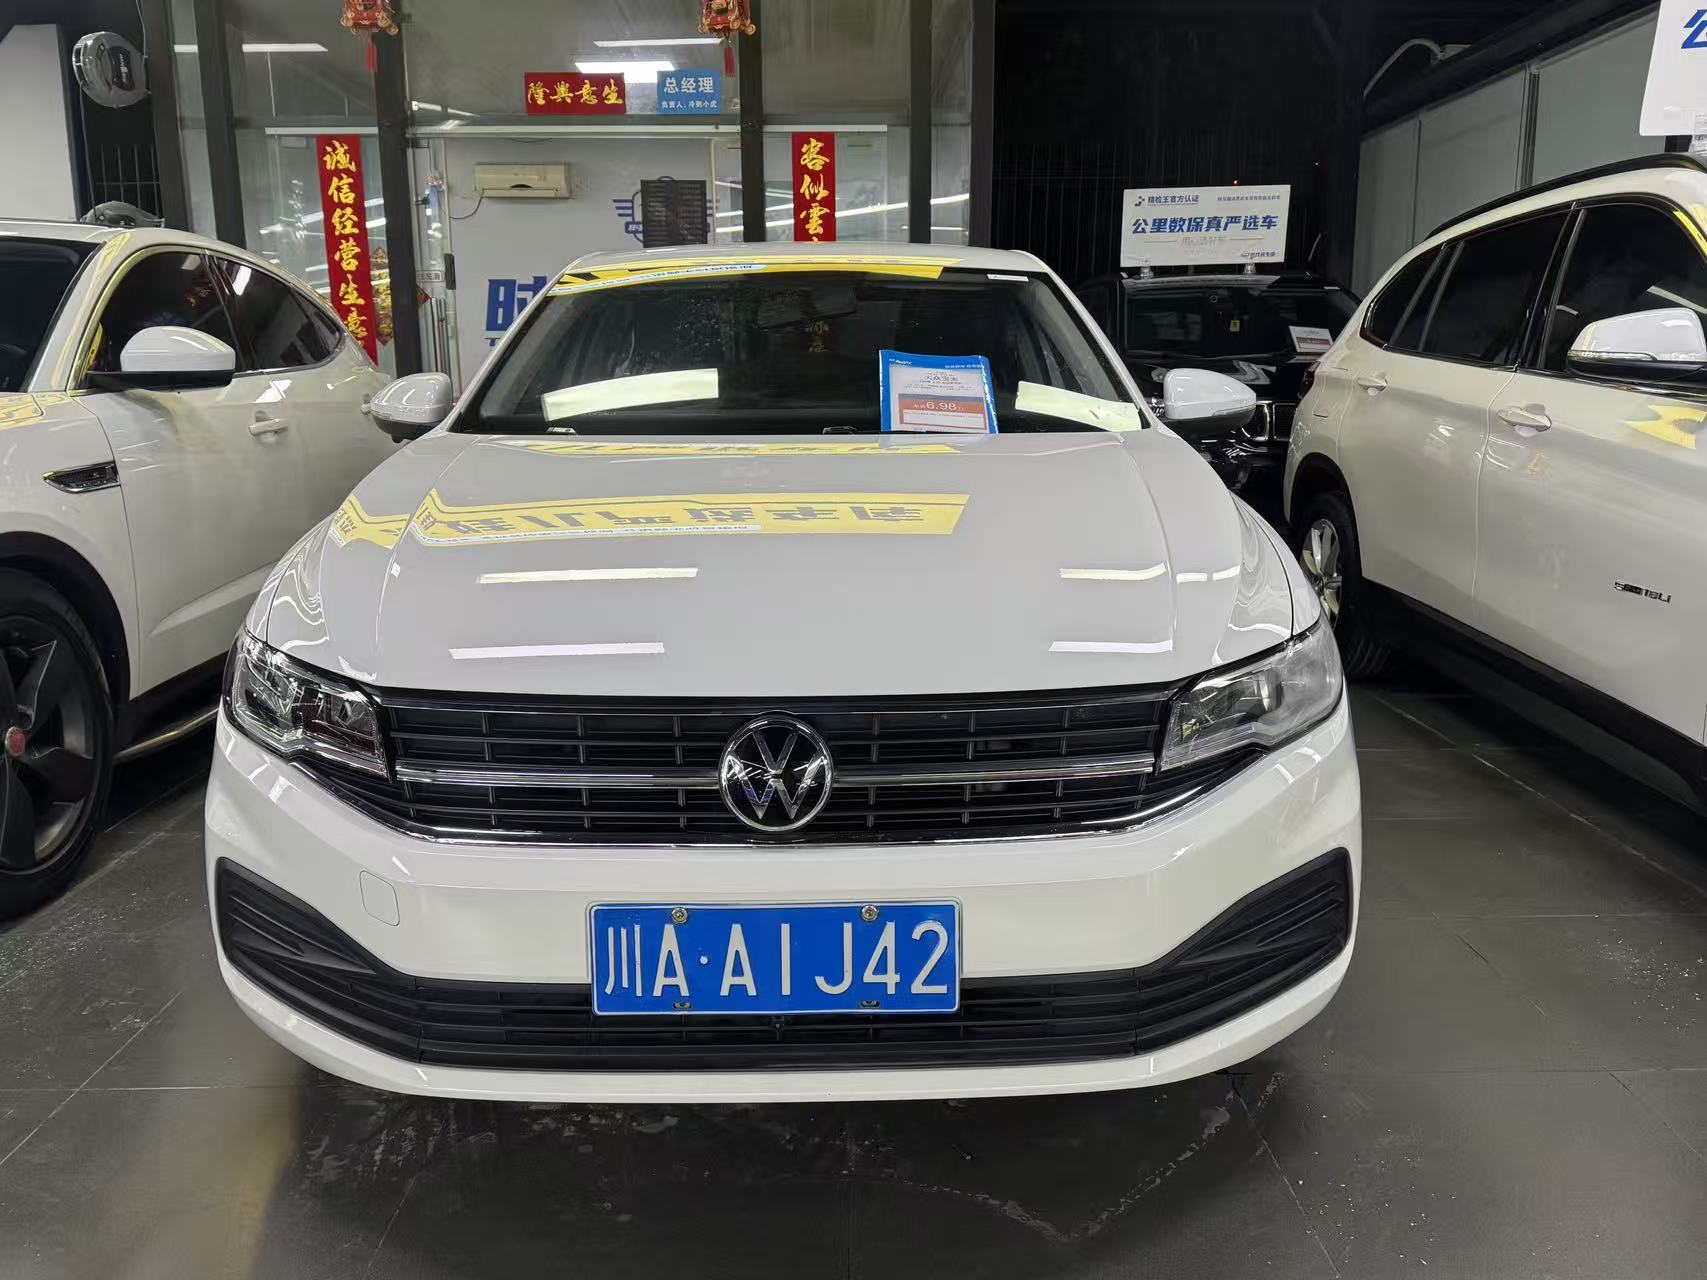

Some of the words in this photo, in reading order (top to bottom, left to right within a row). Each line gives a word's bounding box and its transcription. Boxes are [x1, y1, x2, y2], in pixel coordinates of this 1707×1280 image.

[664, 77, 714, 93] 总经理
[800, 138, 830, 243] 客似雲
[1132, 215, 1279, 234] 公里数保真严选车
[324, 140, 368, 347] 诚信经营生意
[926, 401, 957, 411] 6.98
